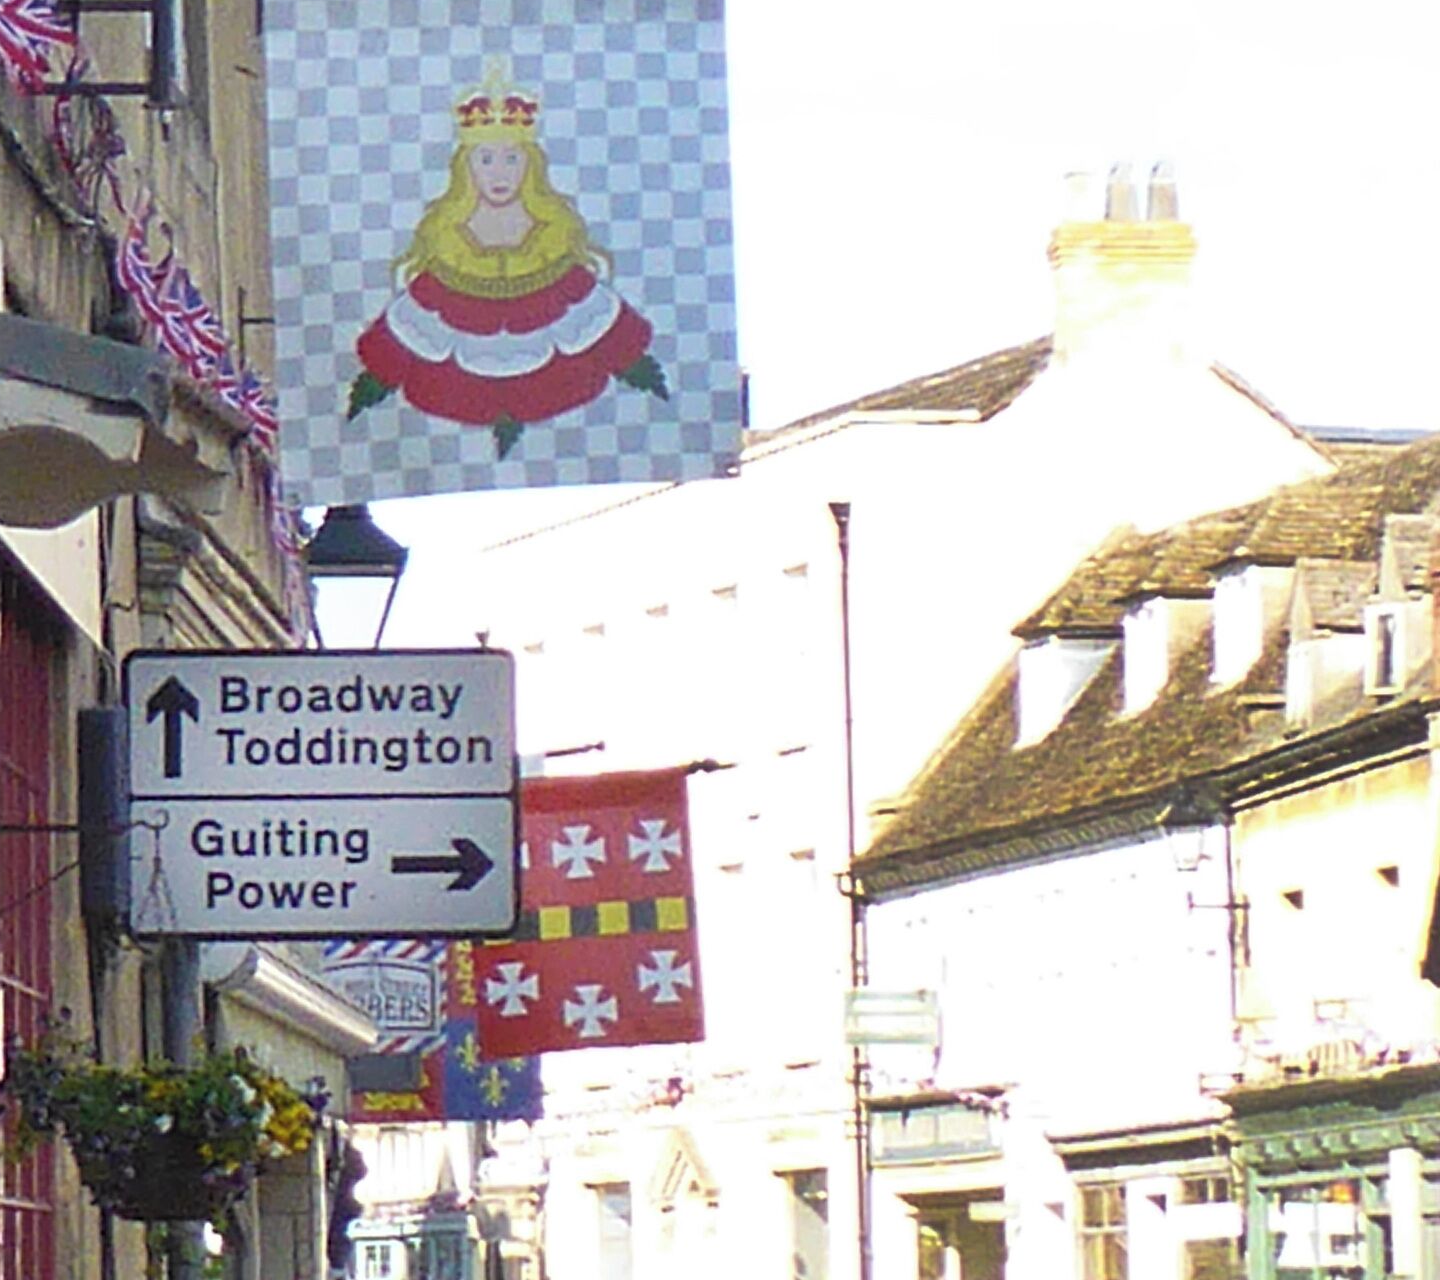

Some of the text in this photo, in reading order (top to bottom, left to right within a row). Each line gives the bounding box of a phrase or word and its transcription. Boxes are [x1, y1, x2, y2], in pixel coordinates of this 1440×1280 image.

[220, 675, 463, 719] Broadway
[216, 727, 493, 771] Toddington
[191, 820, 369, 863] Guiting
[207, 872, 357, 909] Power
